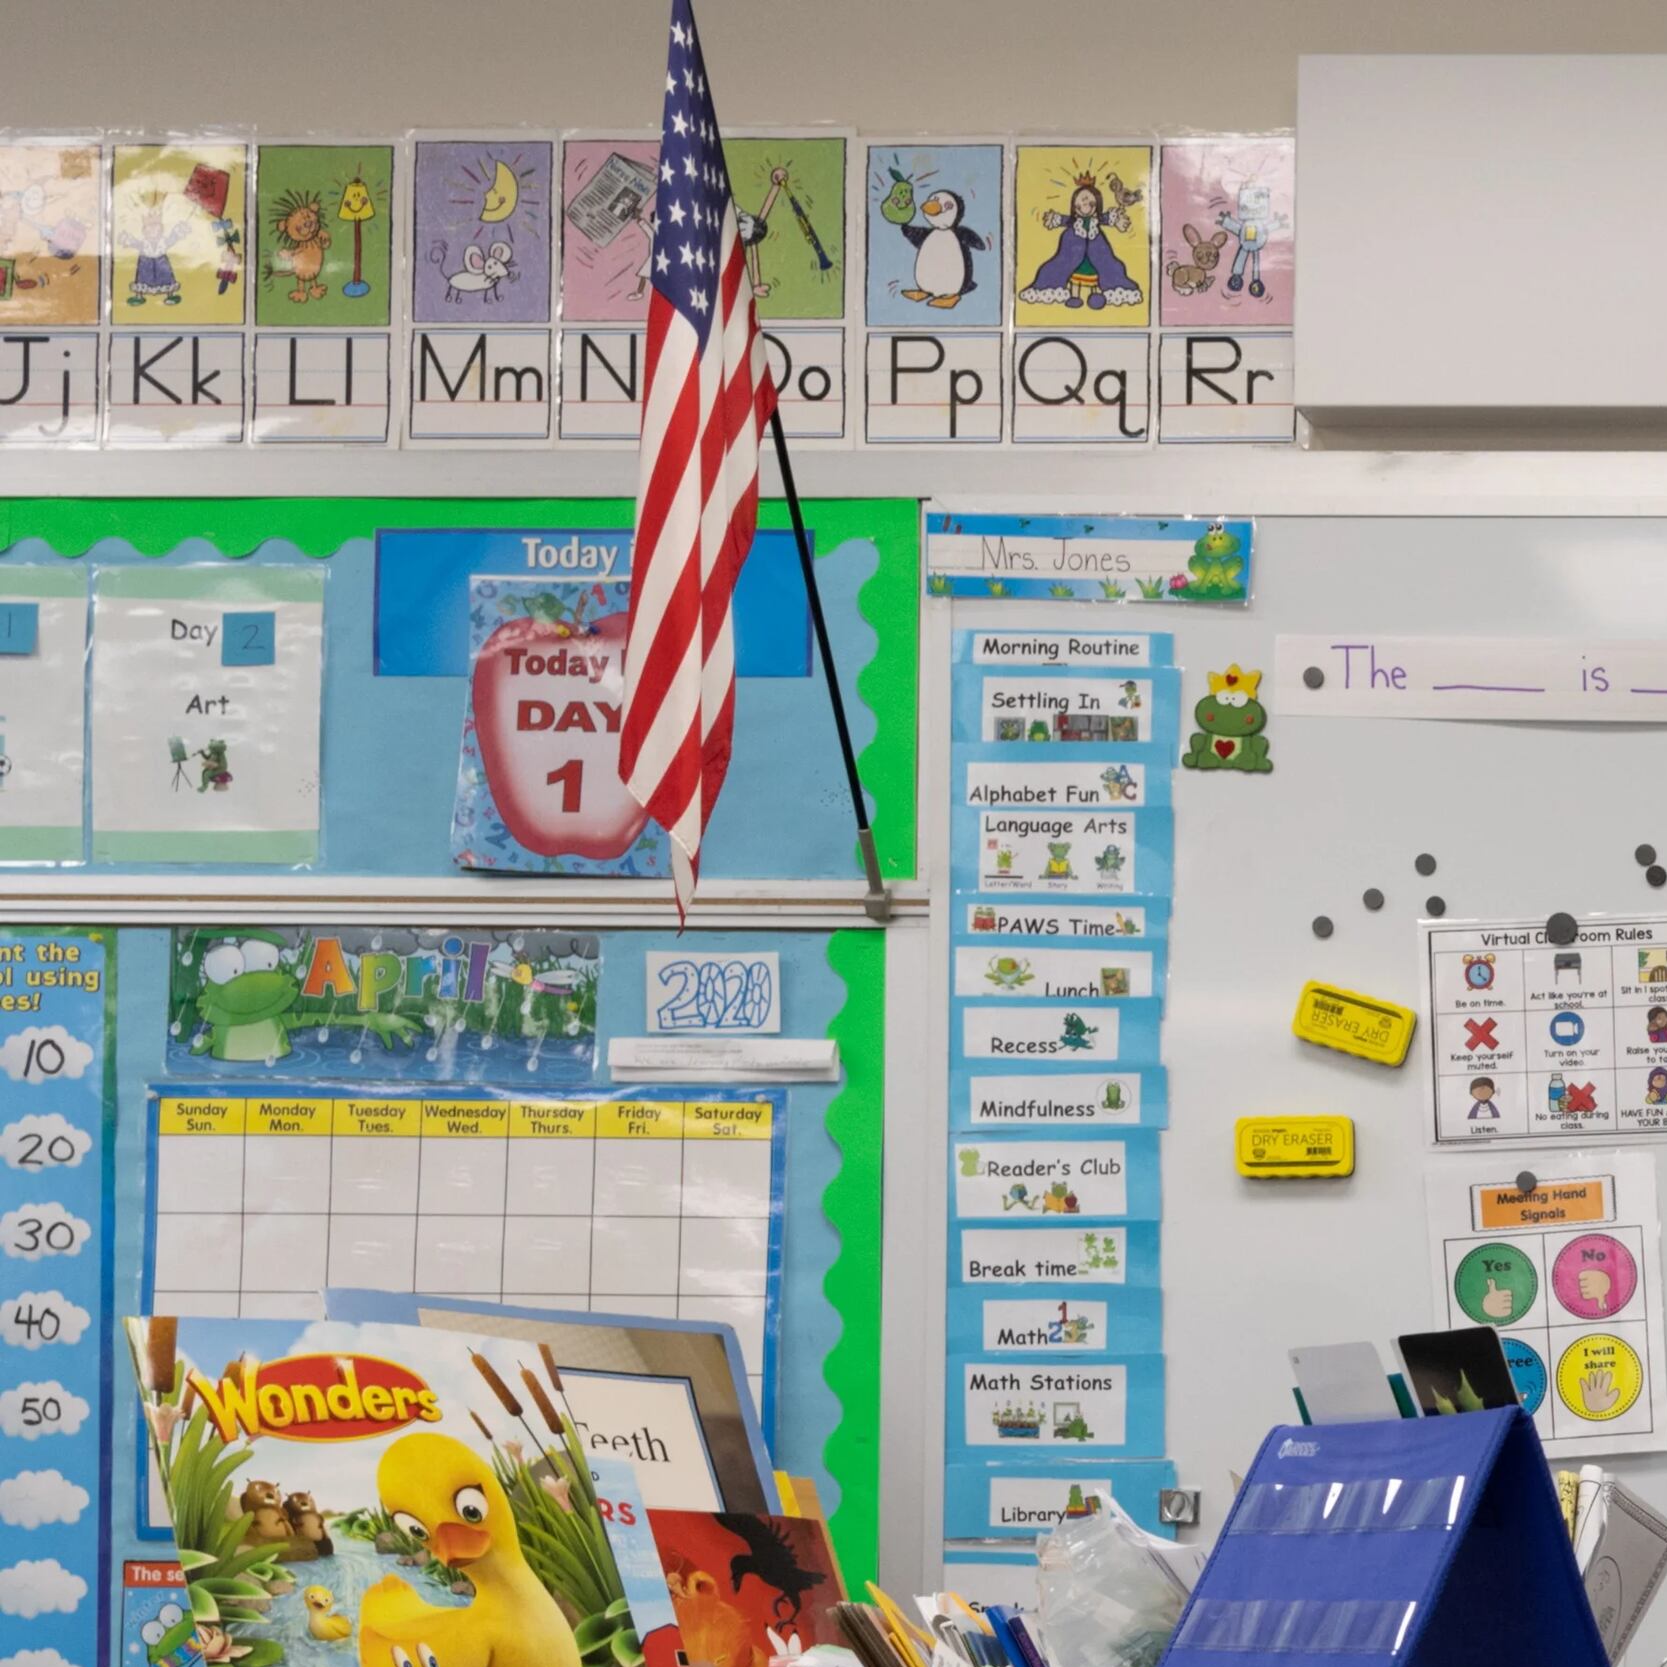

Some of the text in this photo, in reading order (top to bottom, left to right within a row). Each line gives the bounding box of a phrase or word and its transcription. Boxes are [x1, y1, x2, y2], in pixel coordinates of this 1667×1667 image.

[131, 335, 222, 406] Kk
[290, 335, 353, 406] Ll
[420, 333, 544, 403] Mm
[1186, 336, 1275, 404] Rr
[891, 336, 984, 437] Pp
[1019, 335, 1145, 437] Qq
[522, 539, 616, 577] Today
[981, 536, 1131, 572] Mrs. Jones
[171, 619, 265, 651] Day 2
[983, 639, 1139, 660] Morning Routine
[505, 647, 609, 681] Today
[1331, 645, 1609, 691] The is
[185, 692, 230, 716] Art
[992, 692, 1100, 715] Settling In
[546, 760, 581, 812] 1
[969, 785, 1099, 806] Alphabet Fun
[986, 816, 1127, 837] Language Arts
[999, 918, 1115, 935] PAWS Time
[301, 936, 492, 1009] April
[657, 960, 772, 1028] 2020
[24, 1039, 64, 1077] 10
[991, 1038, 1057, 1054] Recess
[176, 1103, 762, 1123] Sunday Monday Tuesday Wednesday Thursday Friday Saturday
[981, 1101, 1094, 1117] Mindfulness
[18, 1133, 76, 1166] 20
[1252, 1133, 1332, 1146] DRY ERASER
[988, 1159, 1121, 1177] Reader's Club
[1521, 1208, 1565, 1223] Signals
[14, 1219, 75, 1251] 30
[970, 1261, 1077, 1277] Break time
[1482, 1259, 1511, 1272] Yes
[1582, 1250, 1606, 1262] No
[13, 1305, 60, 1340] 40
[997, 1329, 1048, 1346] Math
[970, 1374, 1111, 1390] Math Stations
[21, 1396, 62, 1425] 50
[187, 1357, 442, 1441] Wonders
[1001, 1507, 1066, 1525] Library
